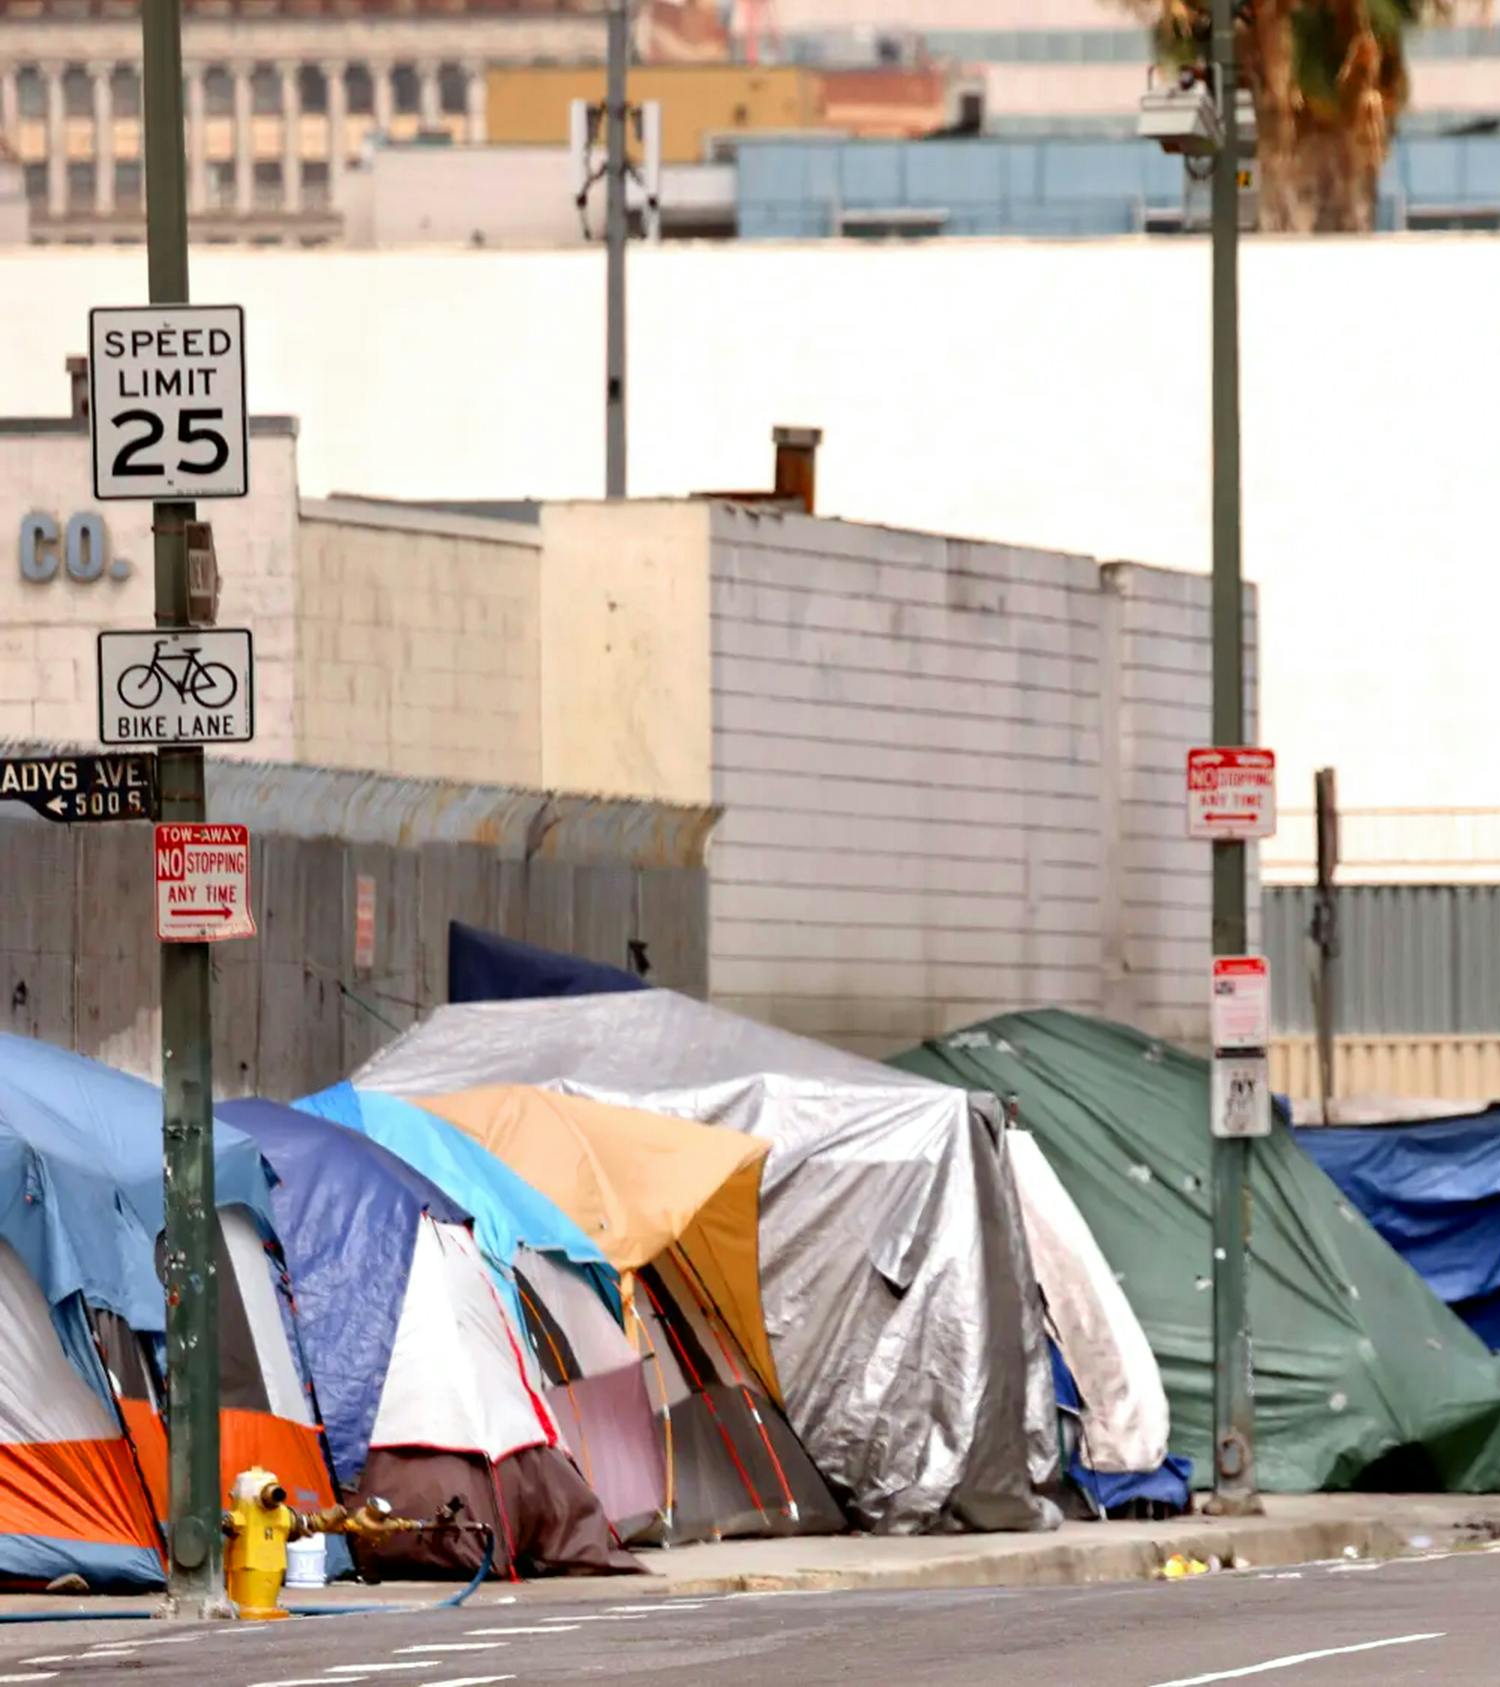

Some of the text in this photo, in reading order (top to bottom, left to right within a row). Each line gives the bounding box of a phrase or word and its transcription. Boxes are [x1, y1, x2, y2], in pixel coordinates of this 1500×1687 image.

[105, 329, 231, 358] SPEED
[118, 368, 217, 397] LIMIT
[111, 408, 230, 477] 25
[20, 511, 131, 583] CO.
[118, 715, 235, 739] BIKE LANE
[0, 757, 149, 793] ADYS AVE.
[75, 791, 120, 816] 500
[162, 827, 242, 843] TOW-AWAY
[158, 848, 245, 877] NO STOPPING
[168, 884, 238, 904] ANY TIME
